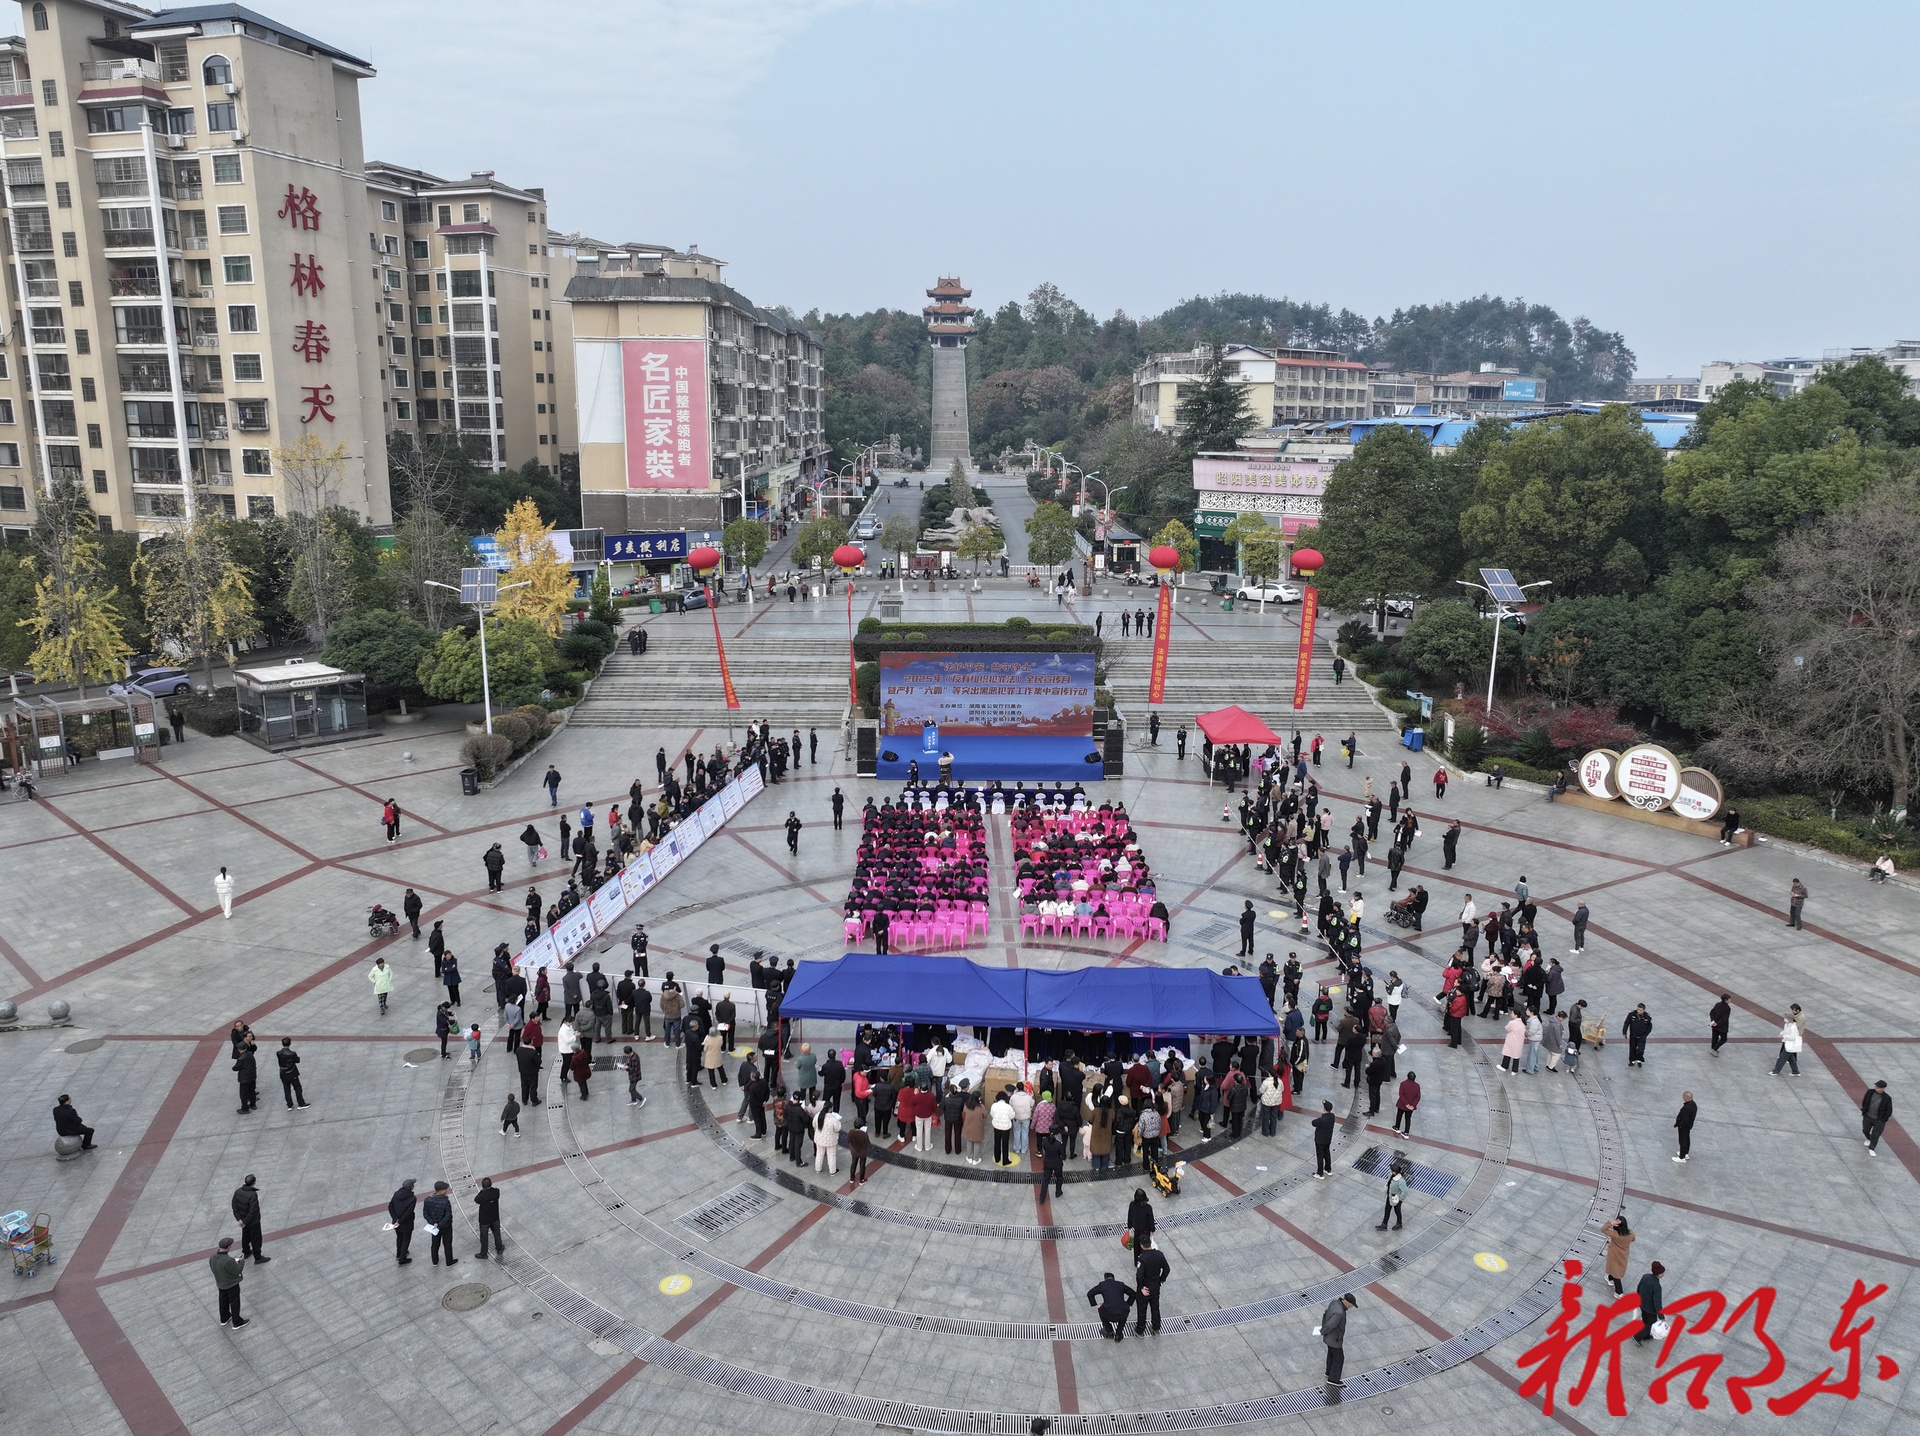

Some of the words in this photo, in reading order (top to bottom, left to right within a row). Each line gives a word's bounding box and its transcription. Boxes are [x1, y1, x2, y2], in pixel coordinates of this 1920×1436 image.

[278, 183, 335, 424] 格林春天
[675, 366, 691, 466] 中国整装领跑者
[612, 538, 681, 556] 多麦便利店
[1302, 592, 1314, 645] 反有组织犯罪法
[1152, 648, 1164, 698] 法律护航守初心
